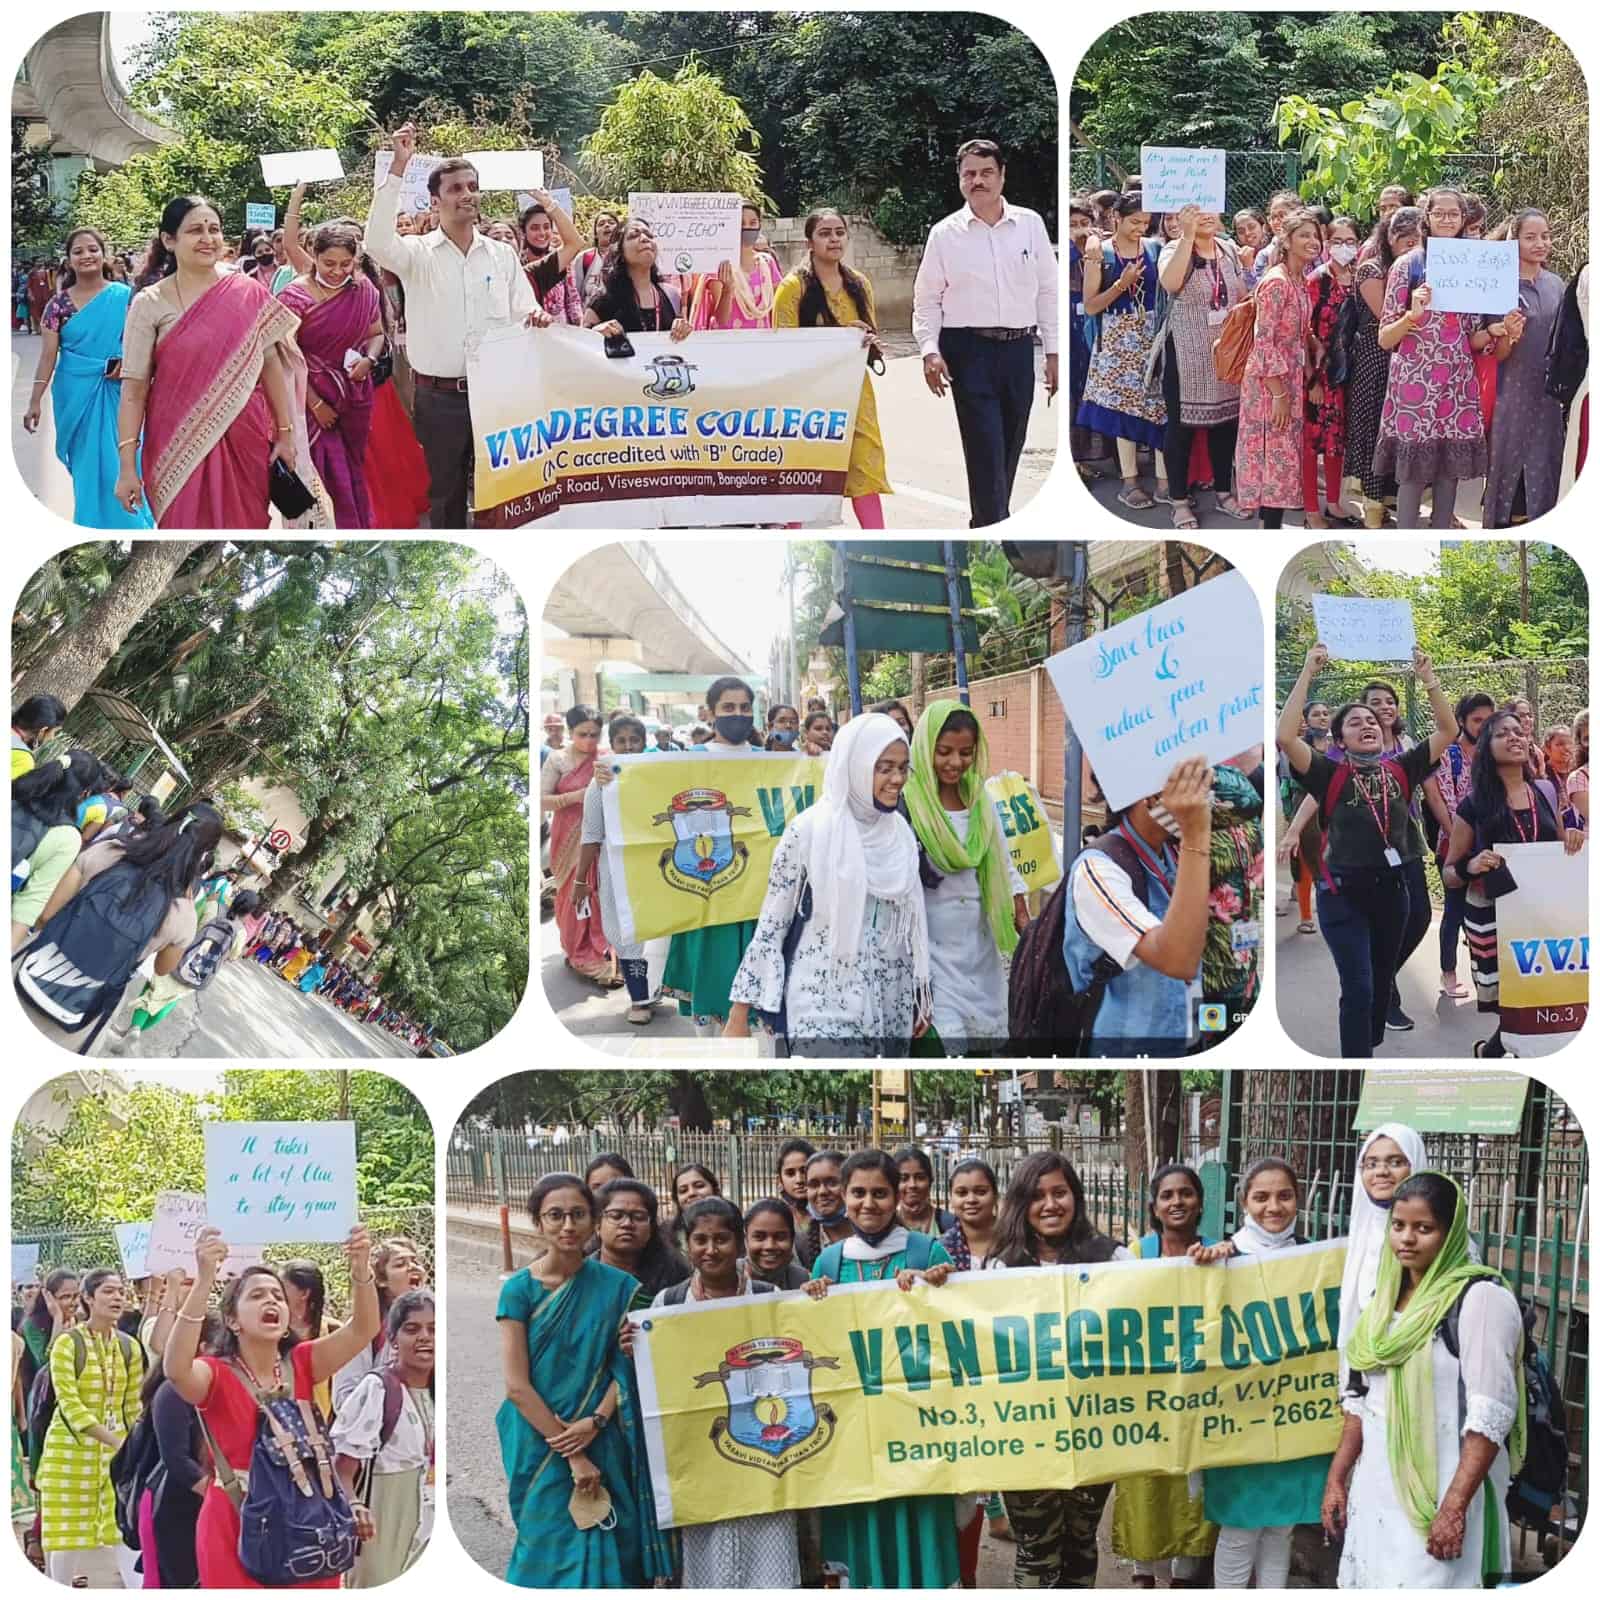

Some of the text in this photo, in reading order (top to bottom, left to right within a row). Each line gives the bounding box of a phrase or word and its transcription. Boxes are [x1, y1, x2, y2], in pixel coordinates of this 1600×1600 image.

[550, 405, 688, 444] DEGREE
[696, 407, 847, 440] COLLEGE
[573, 445, 666, 468] accredited
[671, 444, 700, 462] with
[732, 445, 784, 464] Grade)
[504, 497, 535, 521] No.3,
[567, 475, 604, 493] Road,
[607, 473, 716, 489] Visveswarapuram,
[717, 472, 768, 489] Bangalore
[778, 472, 823, 486] 560004
[1093, 615, 1185, 679] Save trees
[1536, 1006, 1580, 1024] No.3,
[992, 1305, 1207, 1385] DEGREE
[918, 1371, 1339, 1428] No.3, Vani Vilas Road, V.V.Pura
[887, 1435, 1025, 1464] Bangalore
[1055, 1426, 1103, 1452] 560
[1112, 1421, 1169, 1447] 004.
[1203, 1413, 1243, 1438] Ph.
[1273, 1397, 1342, 1428] 2662
